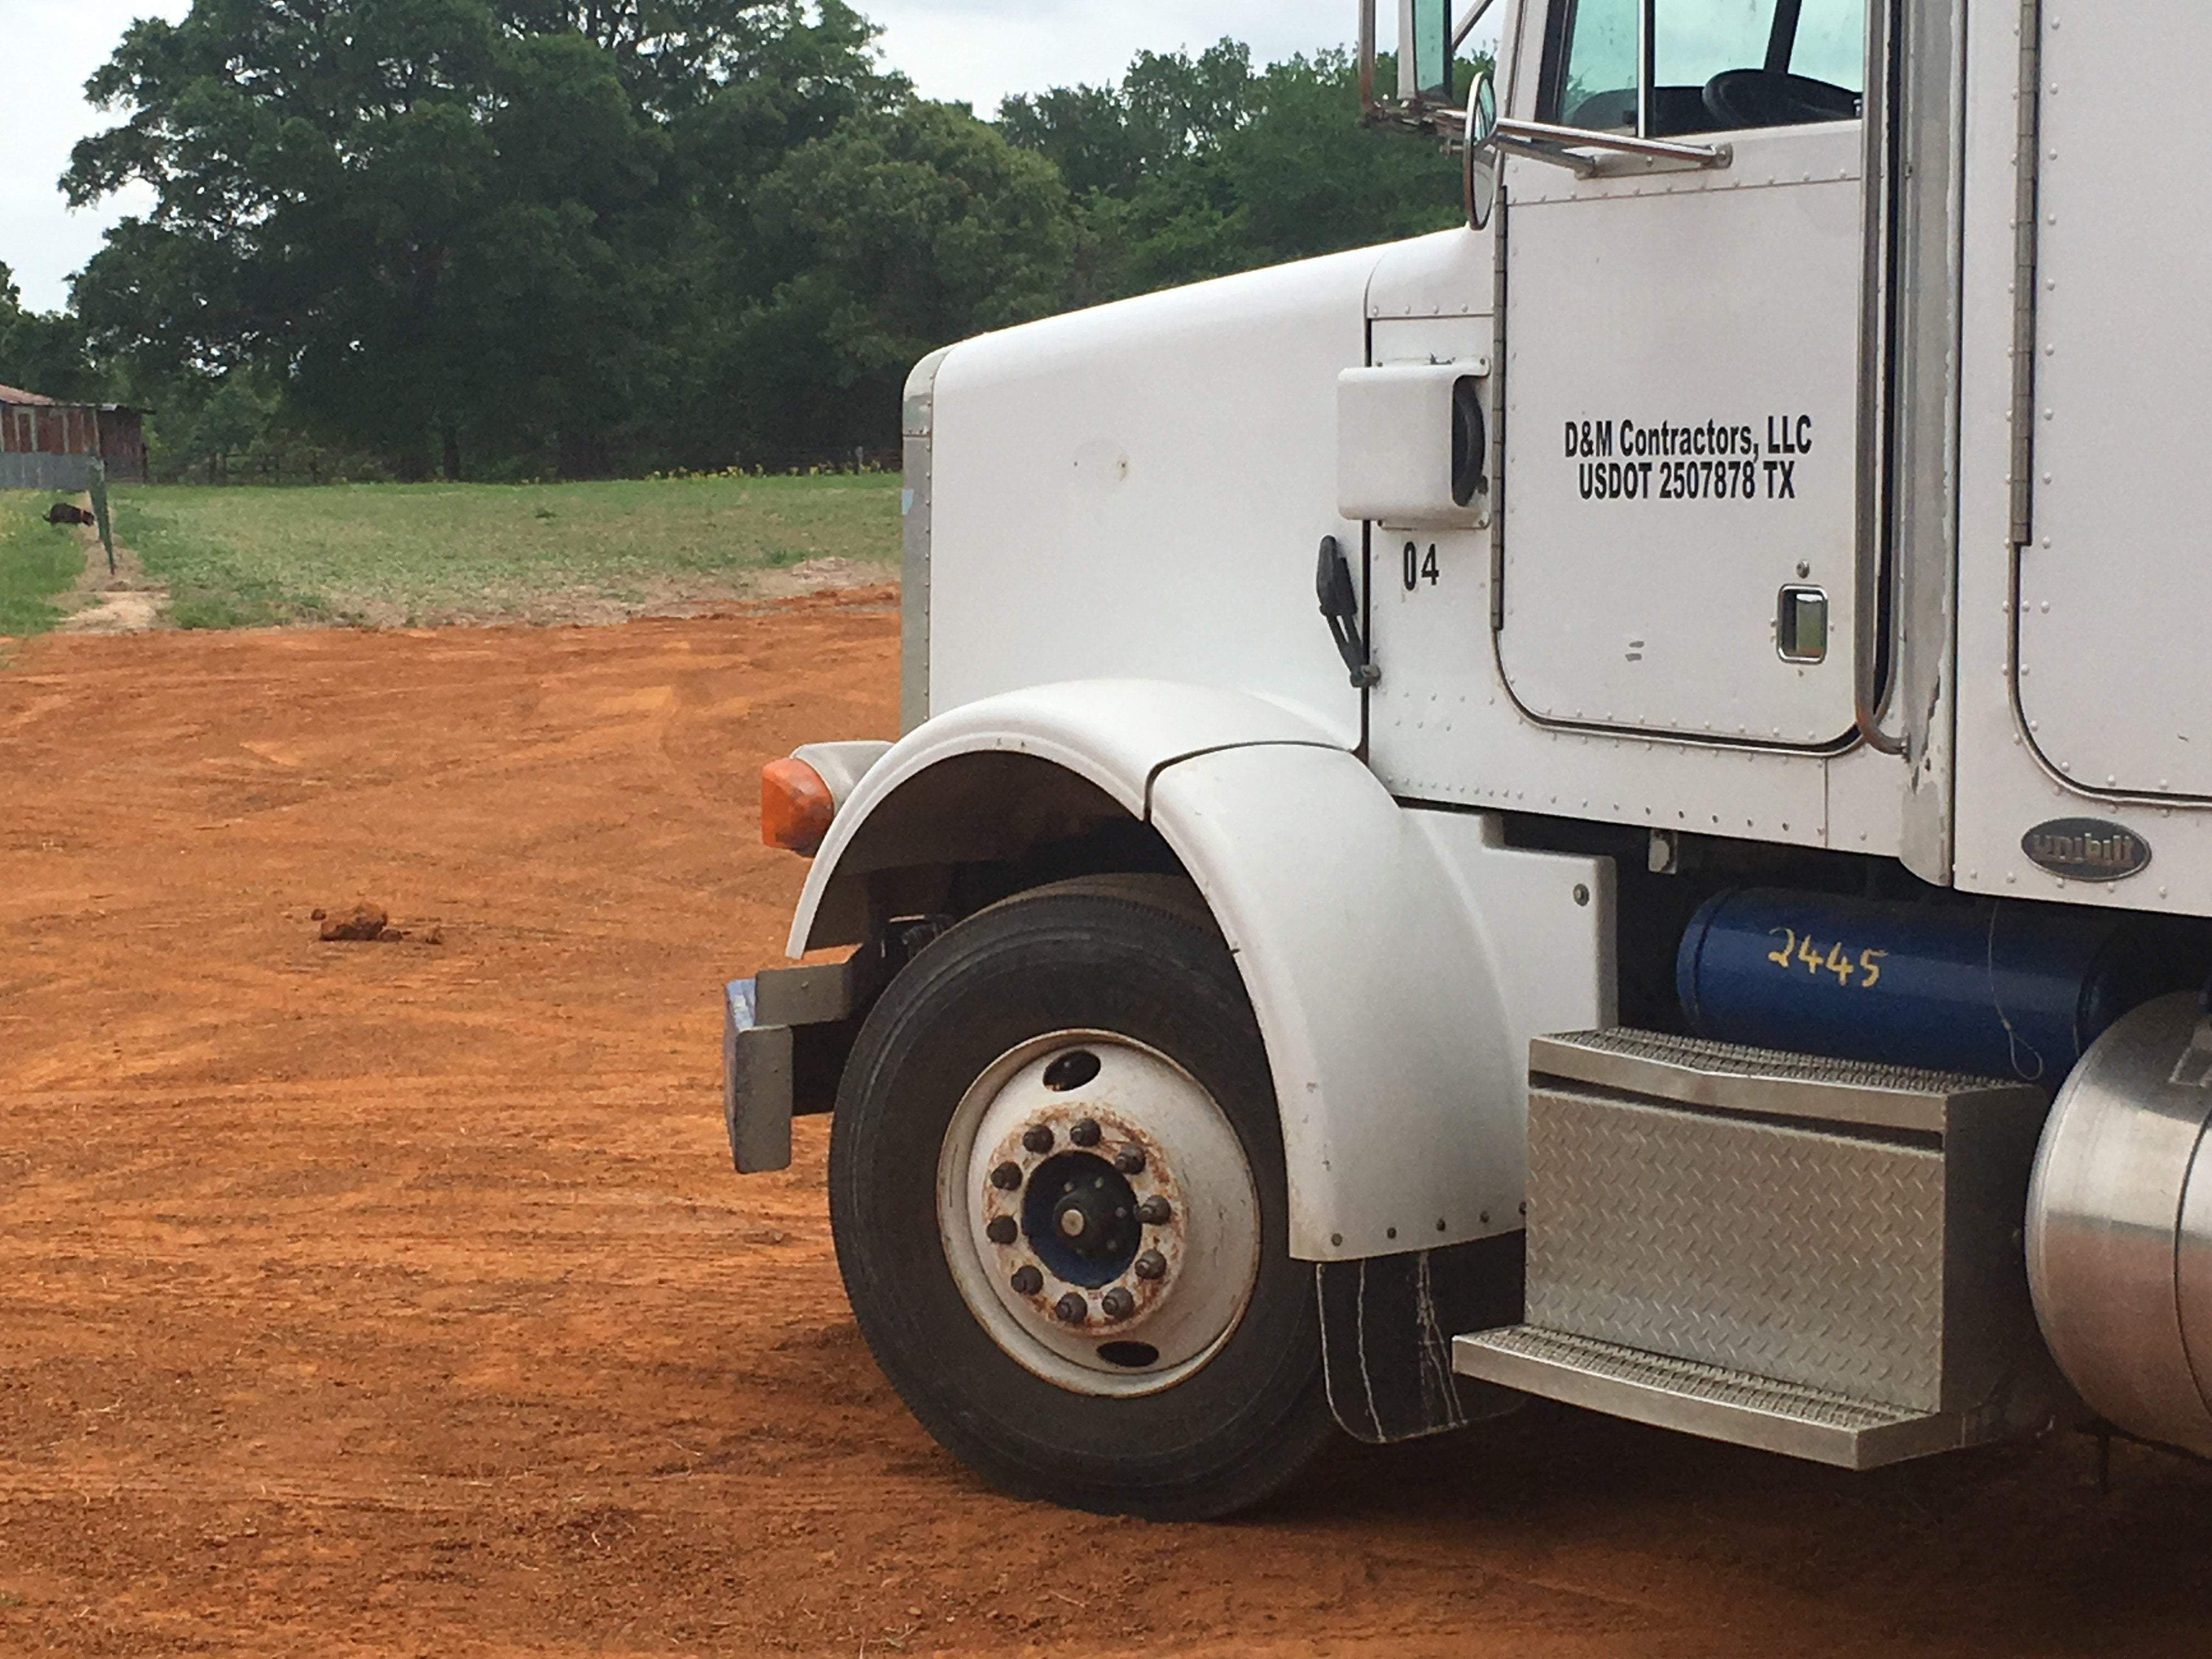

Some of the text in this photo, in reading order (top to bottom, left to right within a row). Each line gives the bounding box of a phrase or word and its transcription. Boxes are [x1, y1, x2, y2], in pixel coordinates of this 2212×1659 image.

[1565, 415, 1812, 463] D&M Contractors, LLC
[1578, 461, 1795, 499] USDOT 2507878 TX
[1404, 541, 1440, 590] 04
[1768, 927, 1889, 987] 2445
